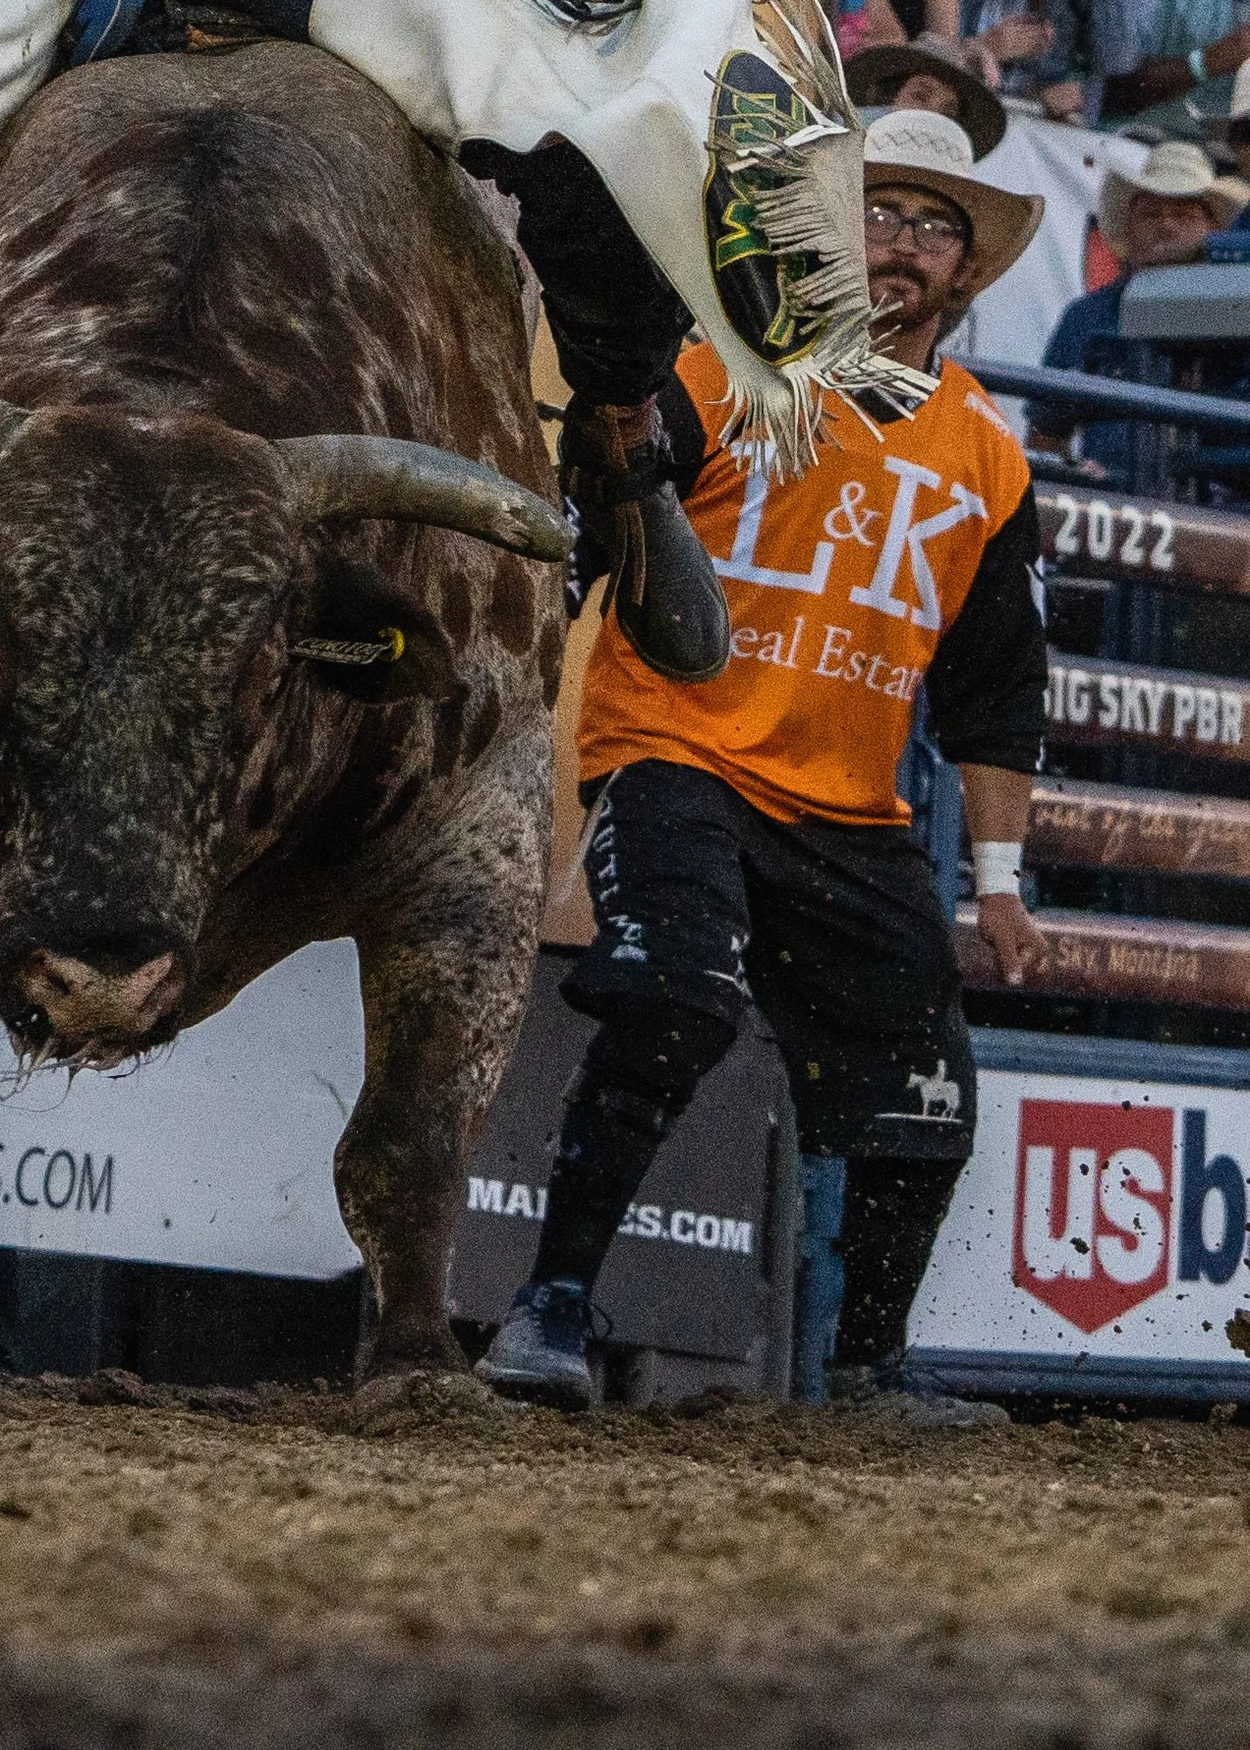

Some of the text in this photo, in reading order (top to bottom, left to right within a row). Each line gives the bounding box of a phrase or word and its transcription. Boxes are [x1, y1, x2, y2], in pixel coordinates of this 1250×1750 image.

[1054, 494, 1175, 572] 2022
[729, 614, 806, 669] eal
[1098, 674, 1163, 736] SKY
[1171, 682, 1245, 745] PBR
